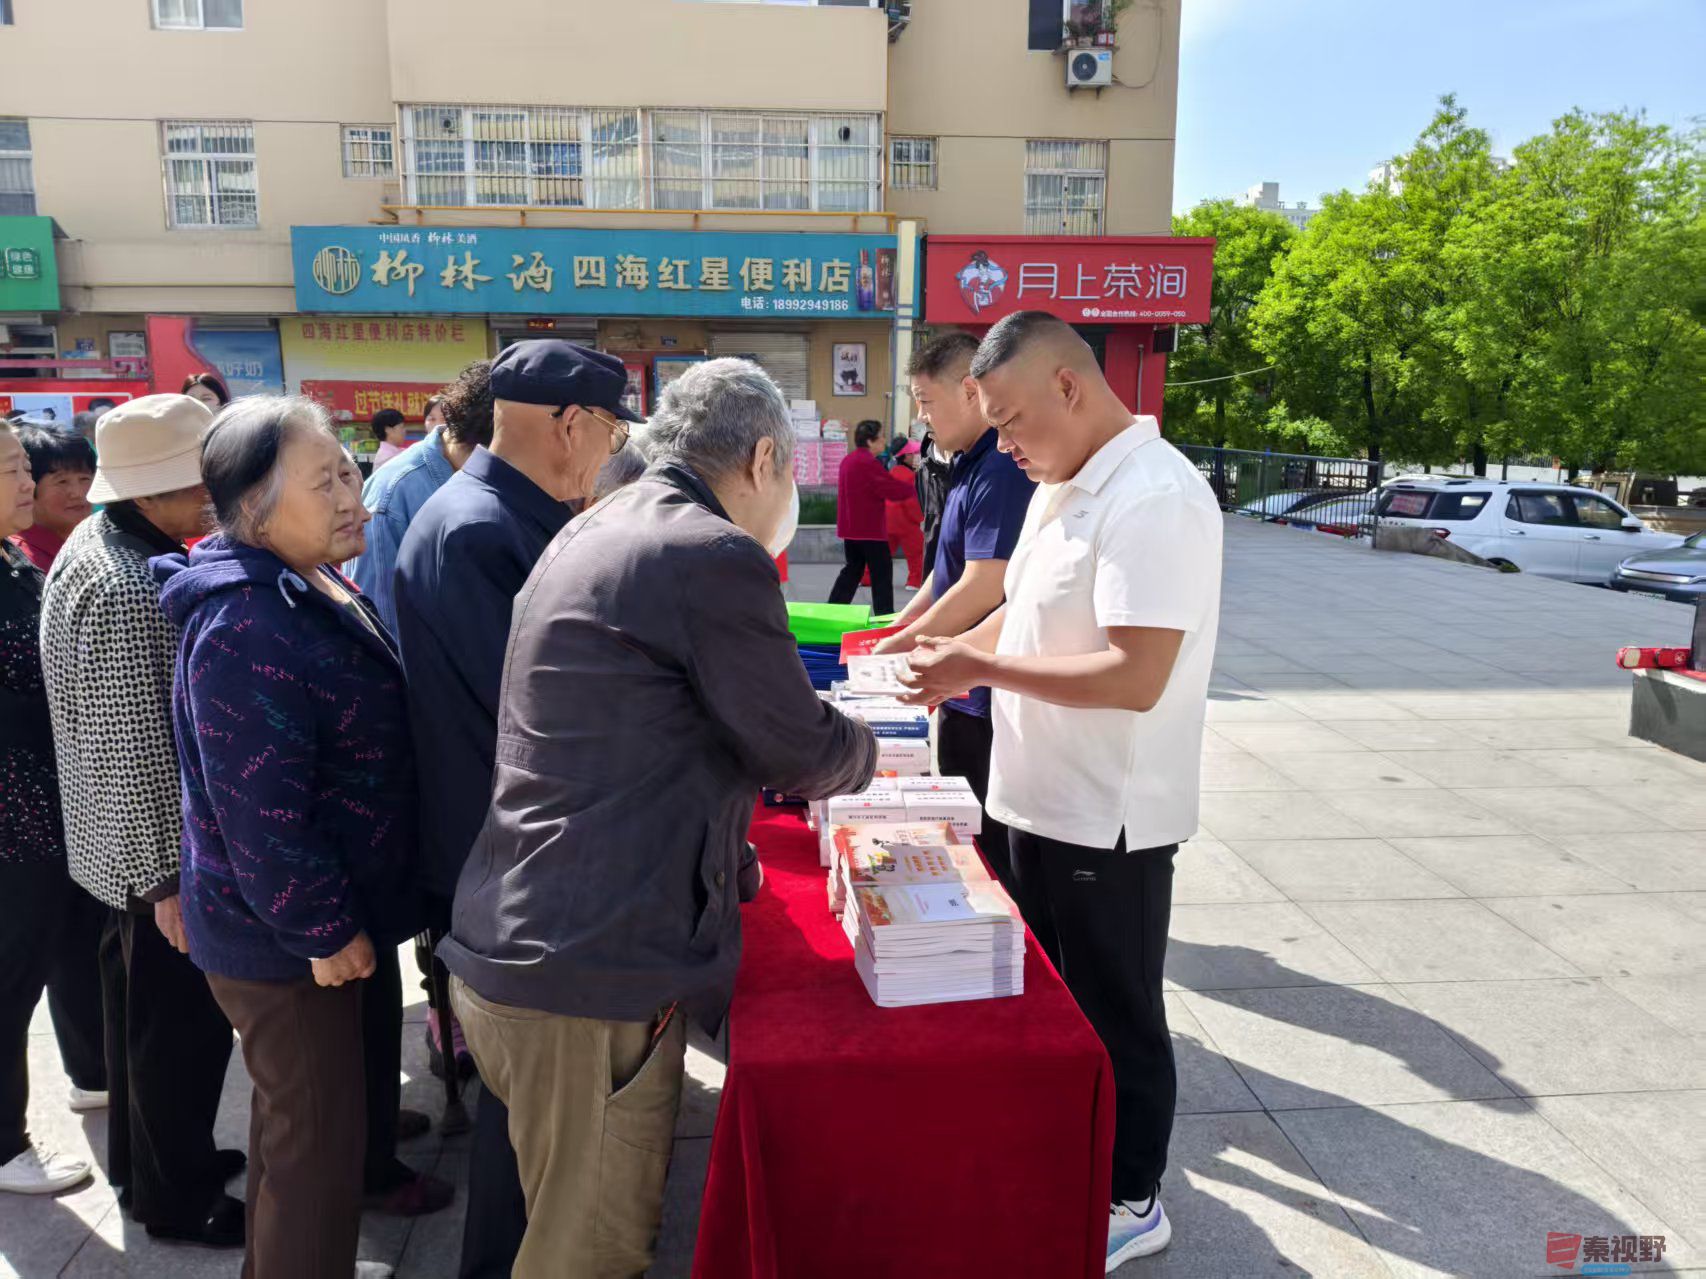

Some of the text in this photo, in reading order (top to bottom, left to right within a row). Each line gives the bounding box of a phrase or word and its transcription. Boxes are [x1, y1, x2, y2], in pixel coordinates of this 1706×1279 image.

[370, 249, 851, 297] 柳林酒 四海红星便利店
[1016, 263, 1188, 300] 月上茶涧
[772, 299, 849, 311] 18992949186
